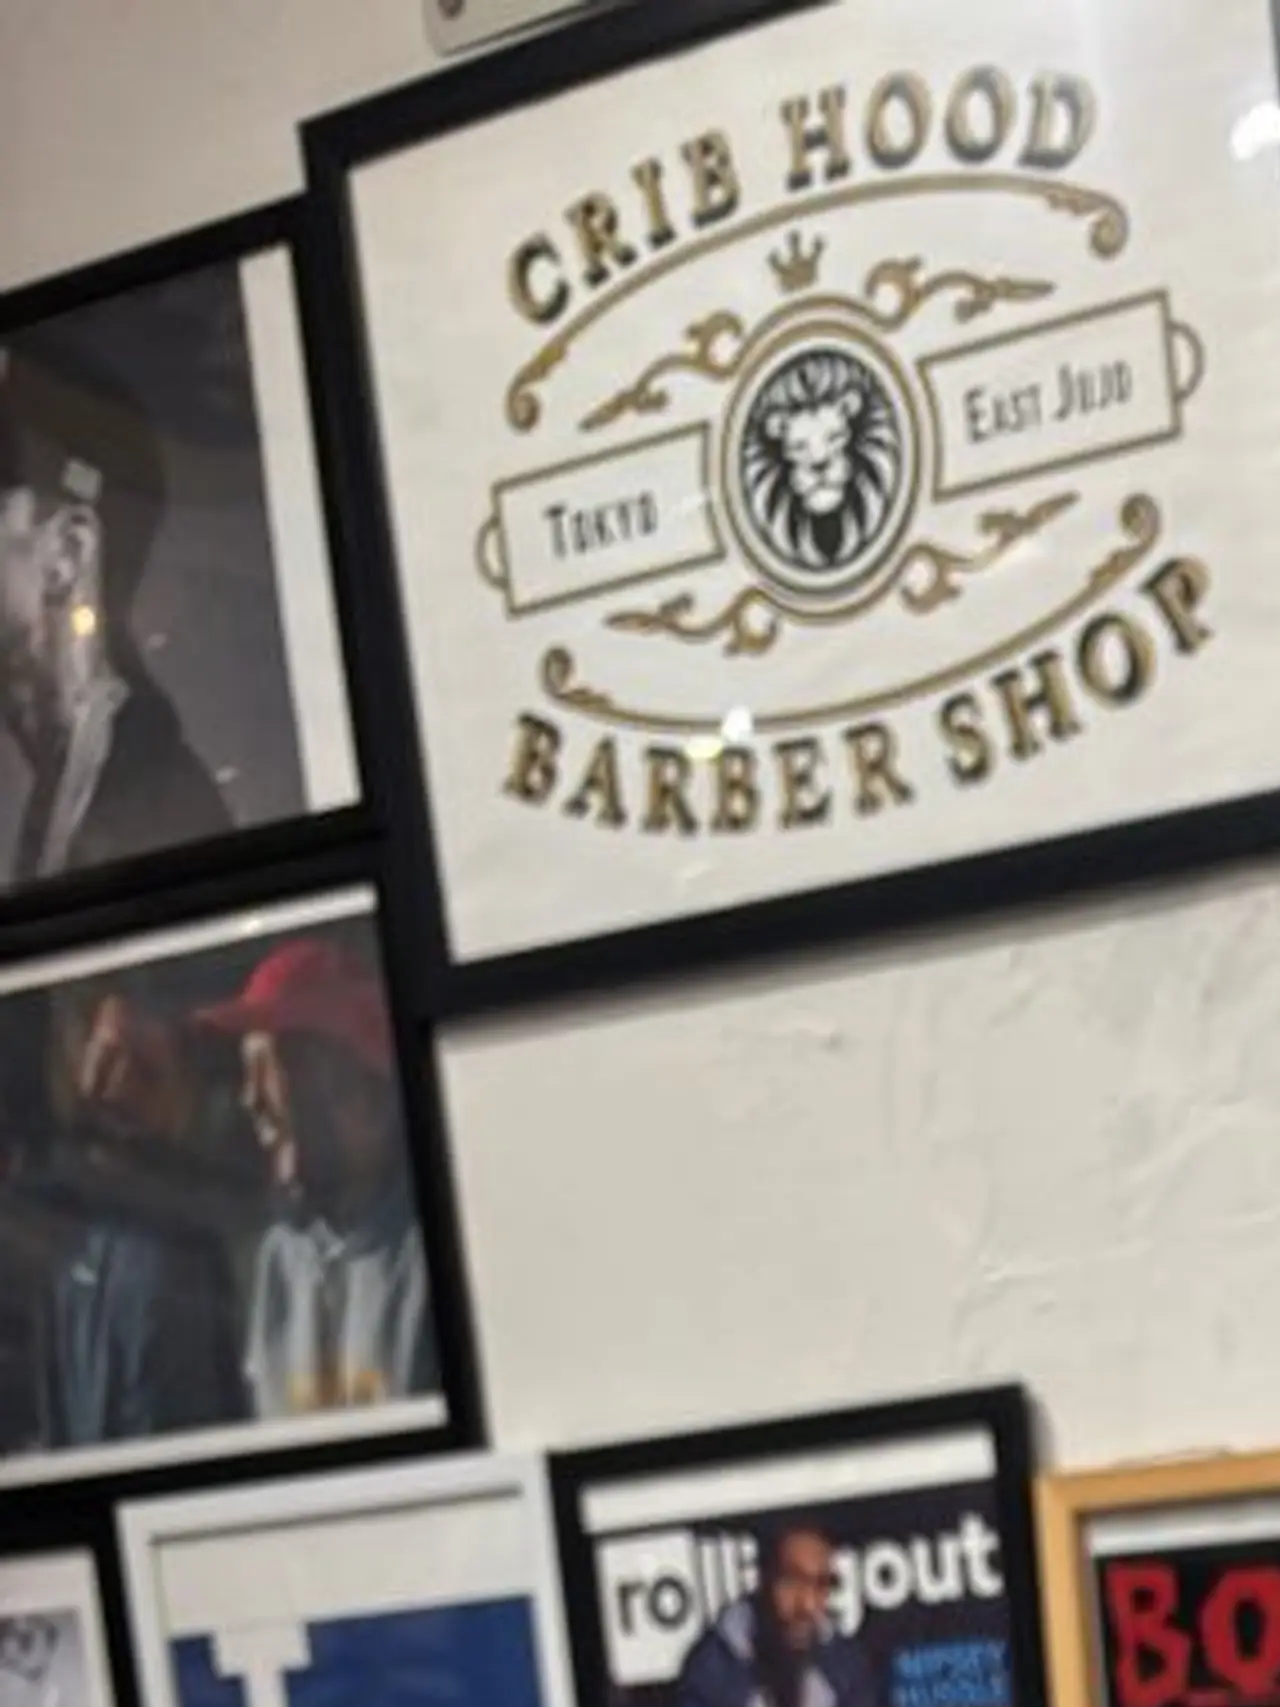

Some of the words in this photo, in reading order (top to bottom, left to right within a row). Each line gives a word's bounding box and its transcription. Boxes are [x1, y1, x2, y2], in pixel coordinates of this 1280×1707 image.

[509, 129, 742, 325] CRIB
[780, 65, 1097, 192] HOOD
[502, 712, 917, 837] BARBER
[939, 553, 1215, 786] SHOP
